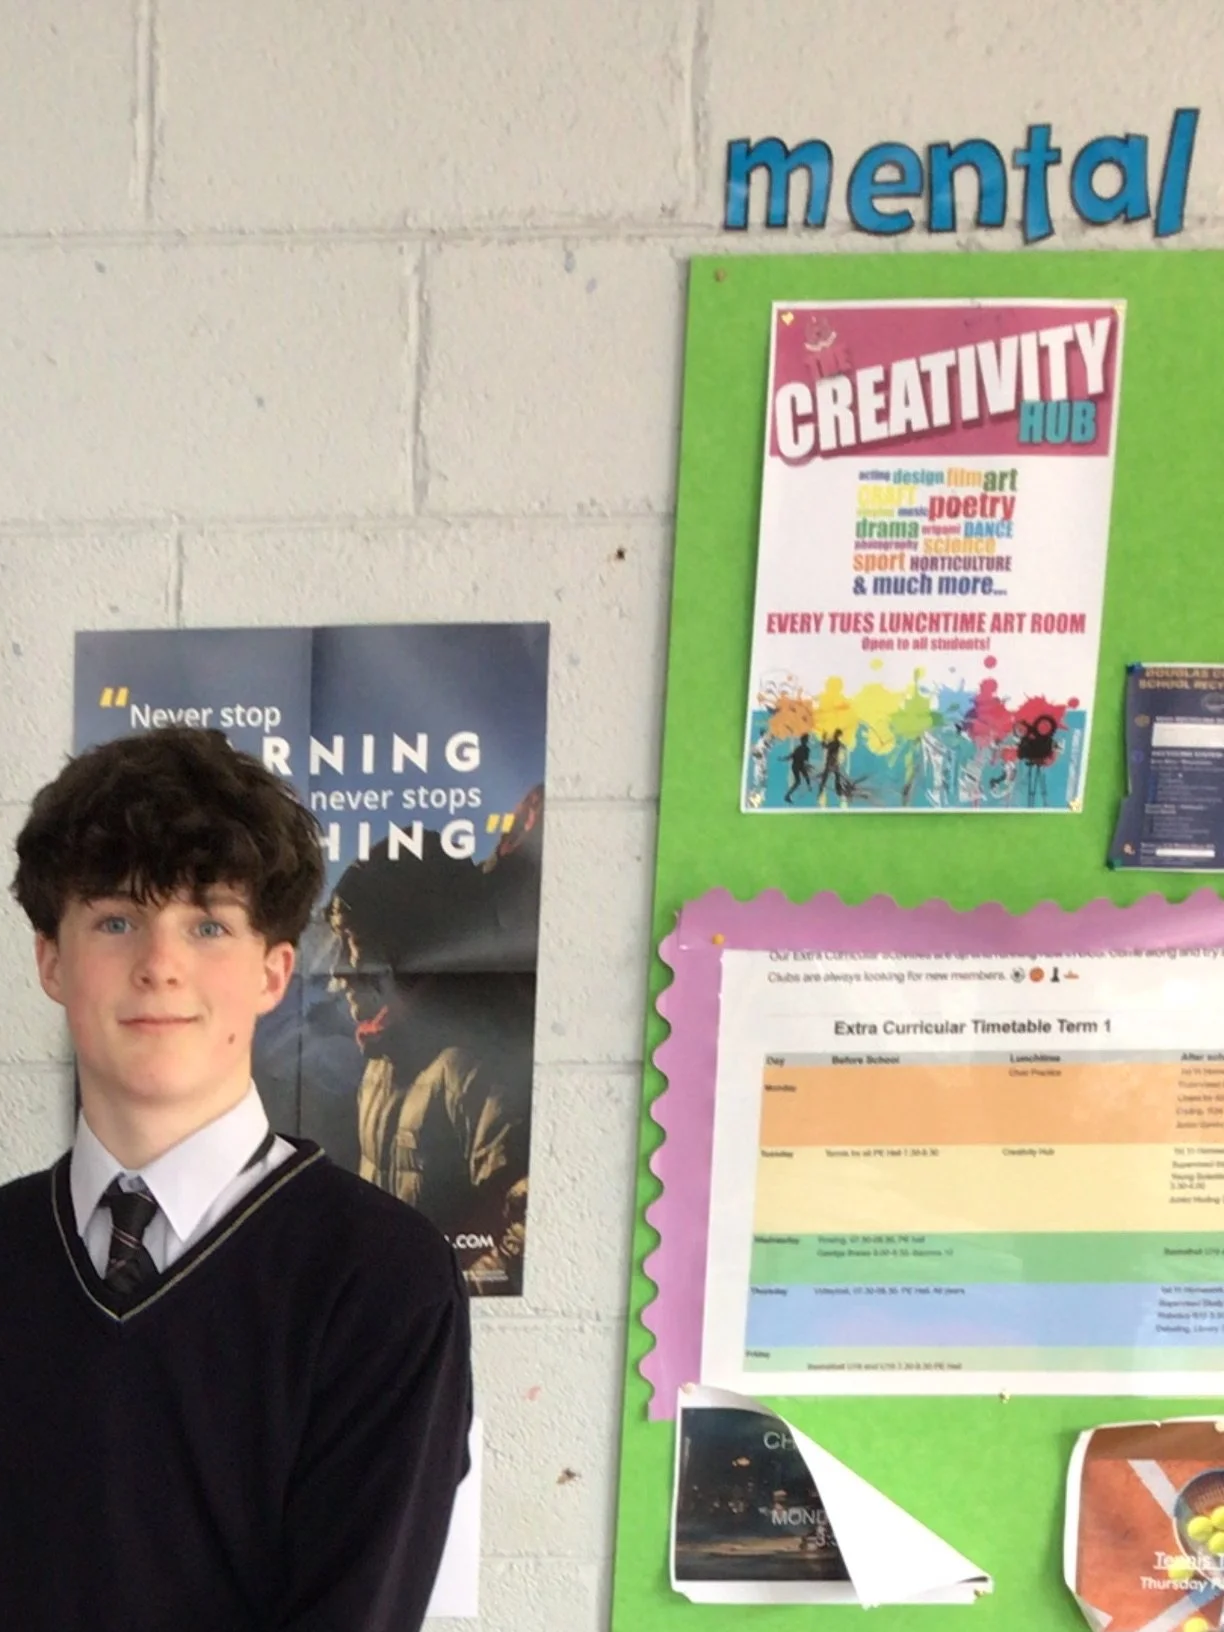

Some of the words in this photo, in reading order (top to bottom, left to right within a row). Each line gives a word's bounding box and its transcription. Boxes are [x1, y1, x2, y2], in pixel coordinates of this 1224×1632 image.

[724, 108, 1200, 245] mental
[776, 316, 1111, 459] CREATIVITY
[1019, 400, 1096, 443] HUB
[892, 468, 945, 486] design
[947, 466, 982, 488] film
[983, 468, 1019, 492] art
[928, 493, 1016, 521] poetry
[855, 517, 919, 538] drama
[963, 520, 1013, 538] DANCE
[923, 537, 997, 555] science
[853, 553, 906, 573] sport
[909, 556, 1012, 572] HORTICULTURE
[852, 575, 867, 596] &
[872, 573, 933, 596] much
[937, 576, 1008, 596] more...
[766, 612, 824, 634] EVERY
[827, 612, 875, 634] TUES
[879, 612, 986, 634] LUNCHTIME
[989, 612, 1027, 634] ART
[1030, 613, 1087, 634] ROOM
[861, 637, 894, 652] Open
[896, 637, 909, 650] to
[912, 637, 928, 650] all
[930, 637, 991, 651] students!
[219, 703, 282, 731] stop
[263, 731, 481, 777] RNING
[311, 789, 393, 811] never
[402, 786, 482, 815] stops
[767, 971, 801, 983] Clubs
[803, 973, 822, 983] are
[823, 970, 862, 985] always
[864, 970, 905, 984] looking
[907, 970, 923, 982] for
[925, 972, 948, 982] new
[834, 1020, 878, 1036] Extra
[882, 1020, 966, 1036] Curricular
[970, 1019, 1052, 1035] Timetable
[1057, 1018, 1098, 1034] Term
[1104, 1019, 1112, 1033] 1
[766, 1056, 785, 1068] Day
[831, 1055, 864, 1065] Before
[866, 1055, 900, 1065] School
[1139, 1576, 1210, 1594] Thursday
